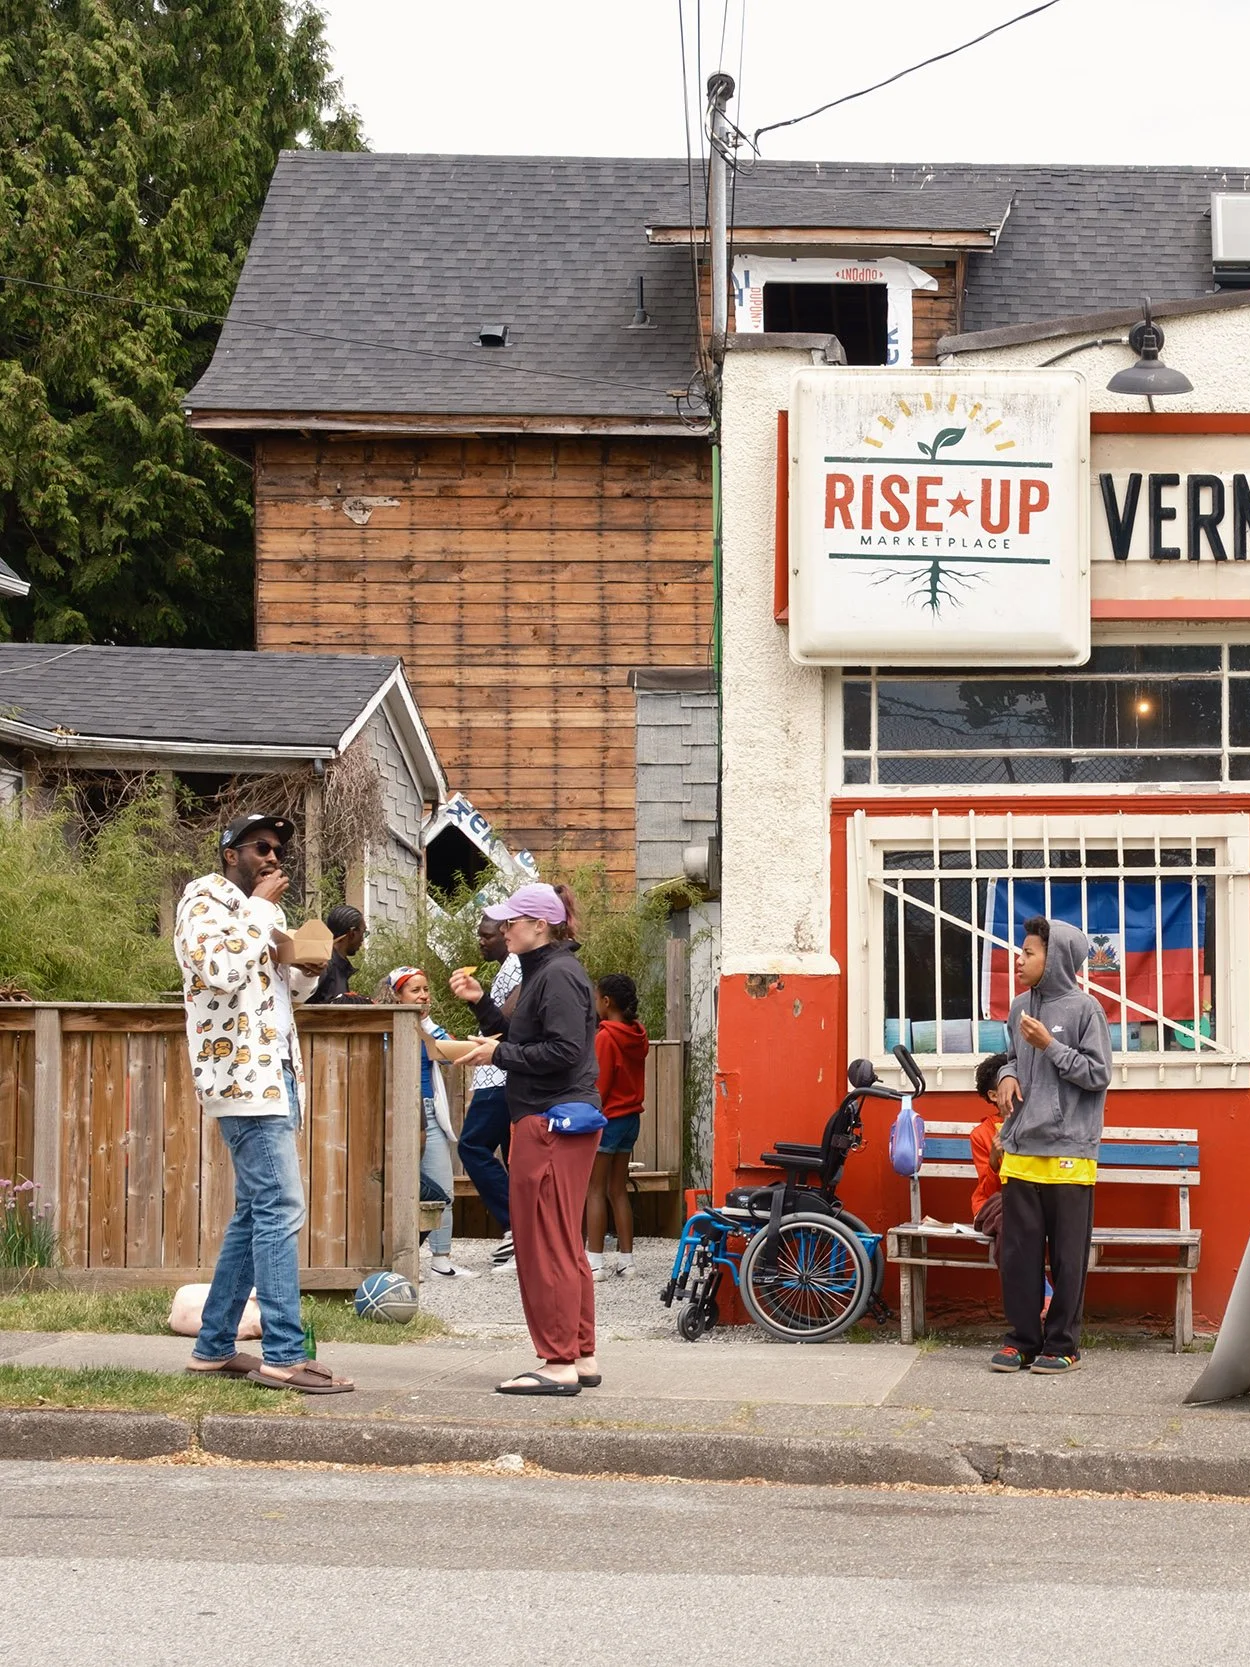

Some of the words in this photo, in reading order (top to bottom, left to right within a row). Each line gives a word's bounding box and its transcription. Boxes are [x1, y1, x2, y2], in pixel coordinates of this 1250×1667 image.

[841, 268, 877, 281] DUPONT
[824, 473, 943, 532] RISE
[980, 478, 1050, 534] UP
[860, 535, 1011, 550] MARKETPLACE
